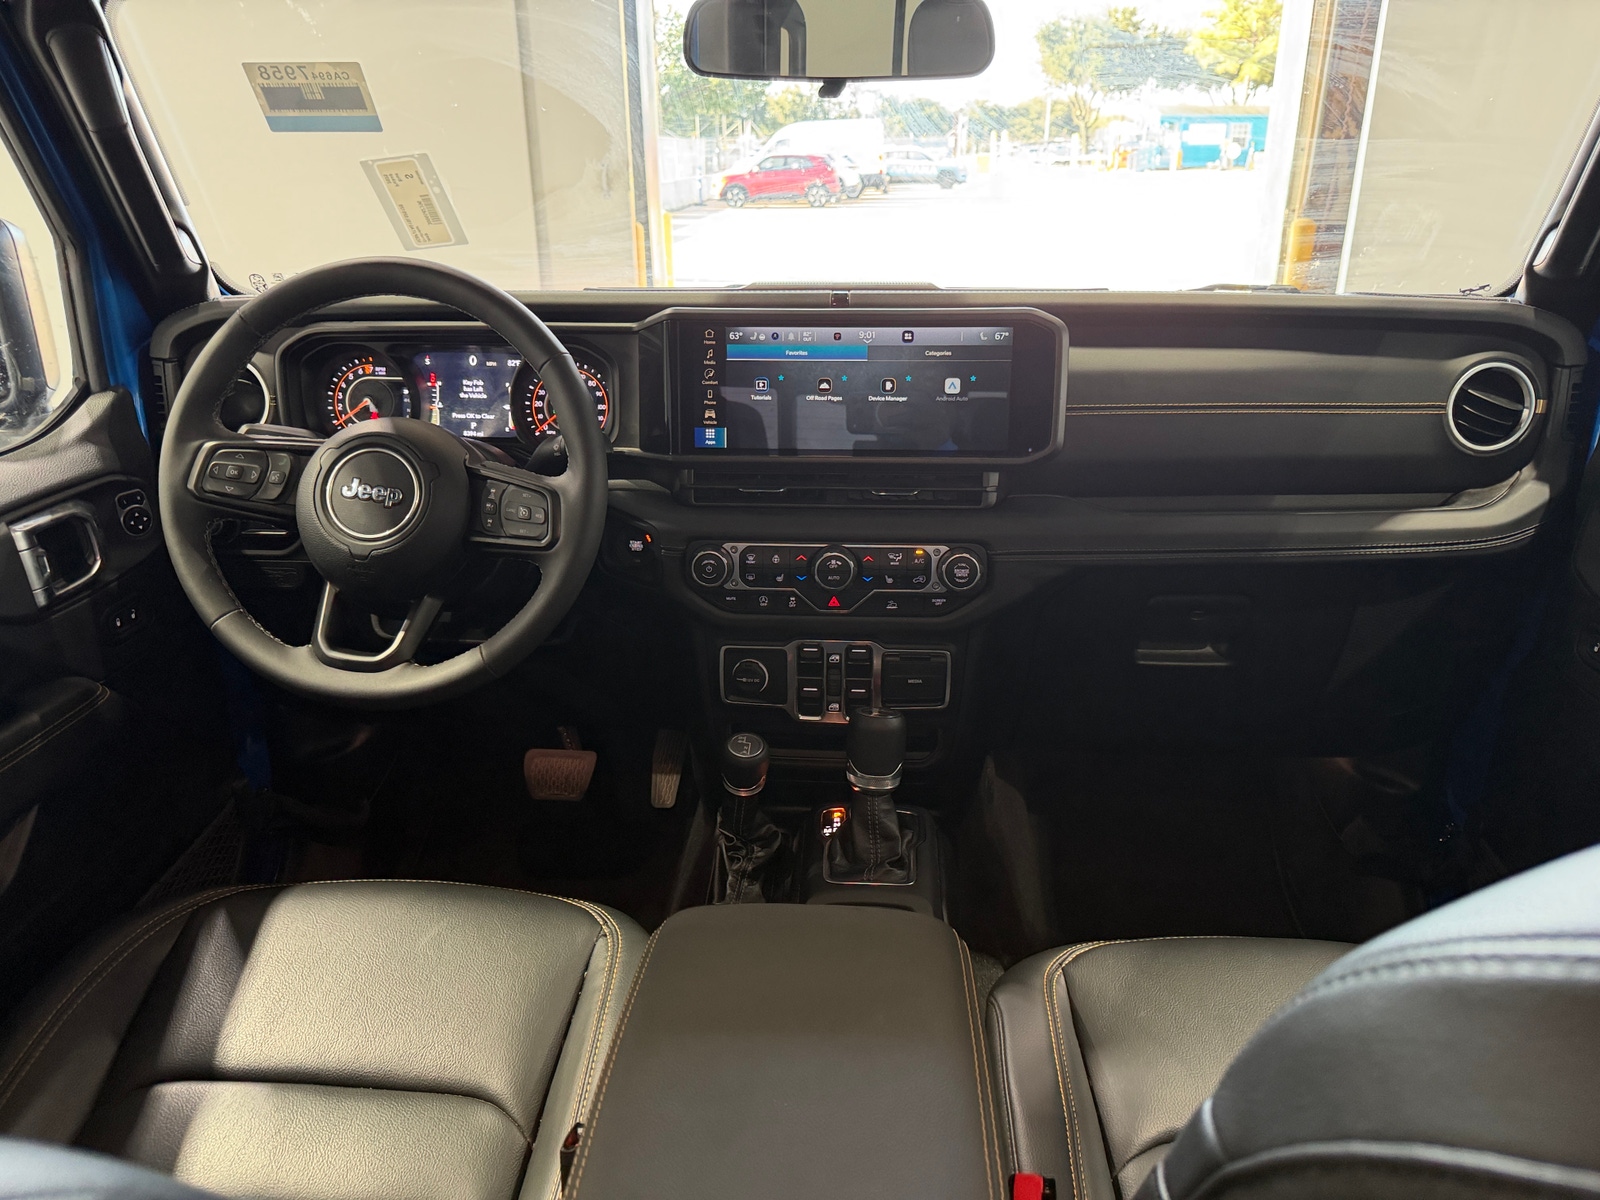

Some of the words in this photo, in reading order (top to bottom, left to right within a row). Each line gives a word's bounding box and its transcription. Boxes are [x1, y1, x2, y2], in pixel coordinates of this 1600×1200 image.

[858, 330, 876, 339] 9:01
[468, 354, 478, 366] 0
[470, 422, 477, 430] P
[341, 477, 403, 508] Jeep
